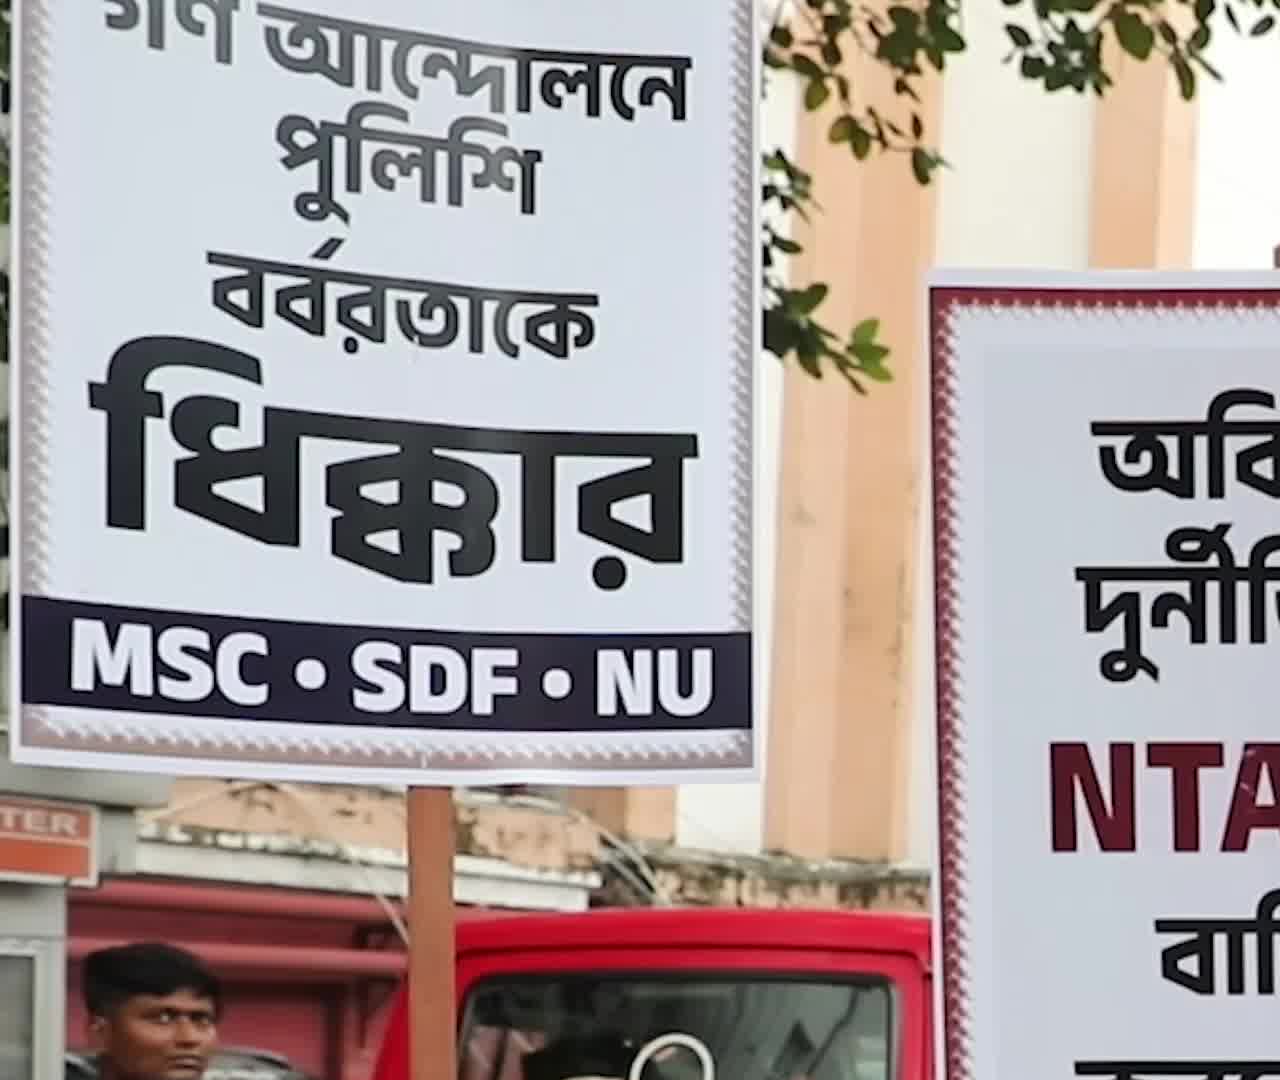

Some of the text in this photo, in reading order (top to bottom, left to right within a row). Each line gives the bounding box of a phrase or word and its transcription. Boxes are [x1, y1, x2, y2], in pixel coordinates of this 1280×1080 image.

[257, 3, 693, 120] আন্দোলনে
[276, 101, 542, 224] পুলিশি
[206, 238, 599, 360] বর্বরতাকে
[88, 336, 698, 590] ধিক্কার
[70, 618, 714, 718] MSC SDF NU
